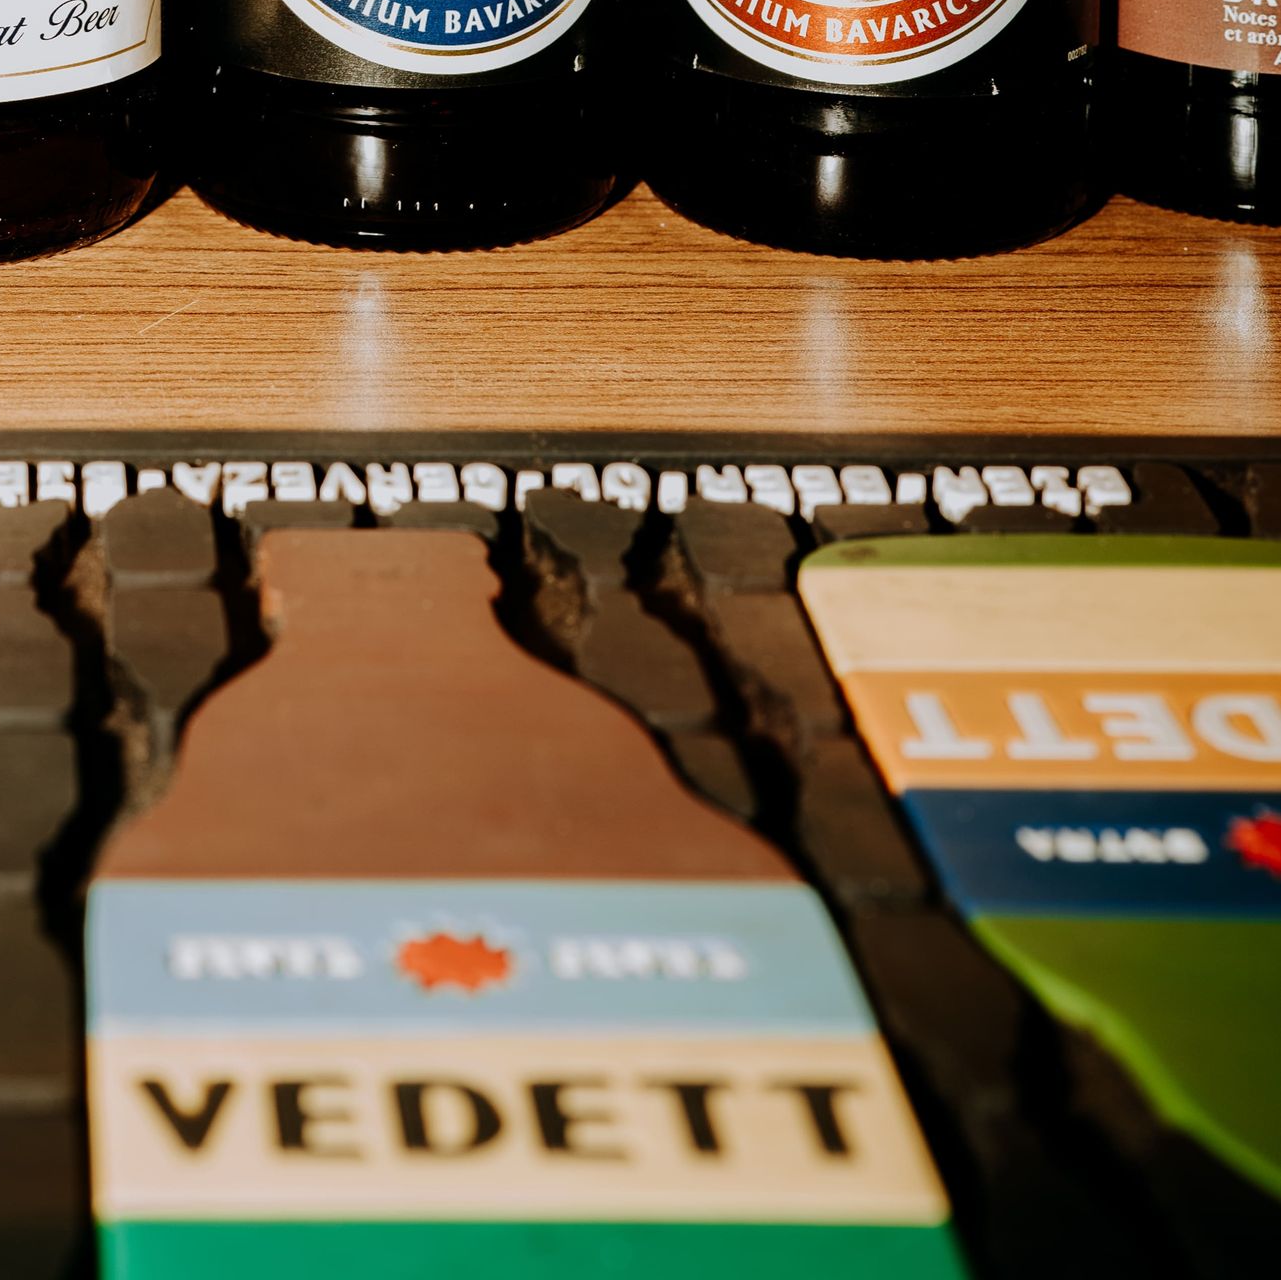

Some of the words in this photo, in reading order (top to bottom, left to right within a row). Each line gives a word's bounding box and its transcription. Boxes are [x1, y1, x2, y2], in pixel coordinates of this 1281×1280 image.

[1223, 5, 1277, 27] Notes
[1224, 28, 1242, 42] et
[1247, 29, 1281, 46] arô
[172, 462, 508, 518] CERVEZA
[697, 465, 892, 523] BEER
[933, 465, 1132, 524] BIER
[140, 1076, 866, 1159] VEDETT
